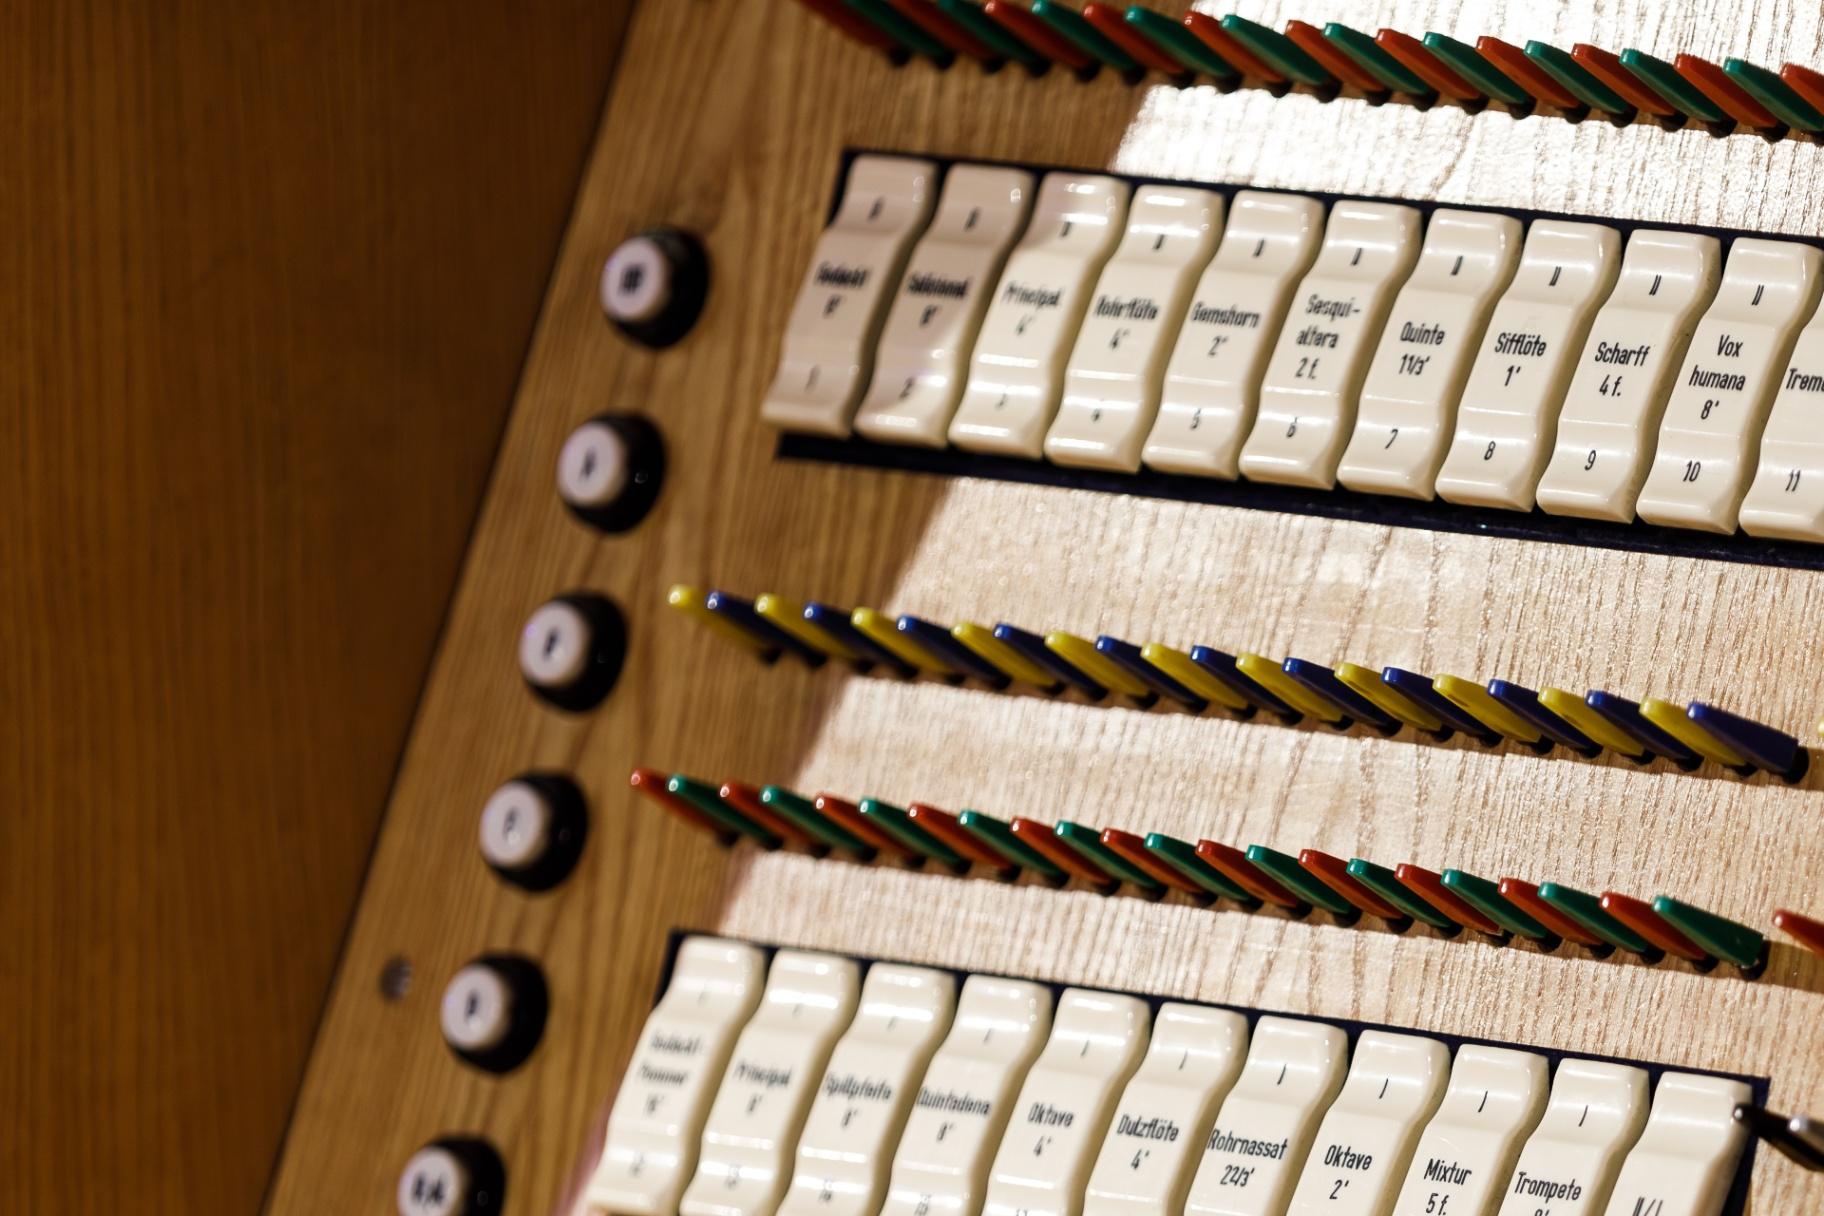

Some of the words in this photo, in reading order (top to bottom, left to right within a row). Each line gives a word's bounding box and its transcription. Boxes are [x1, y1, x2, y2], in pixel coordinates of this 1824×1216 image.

[1003, 280, 1063, 311] Principal
[1648, 274, 1663, 296] II
[1750, 284, 1765, 306] II
[1191, 301, 1261, 328] Gemshorn
[1304, 293, 1361, 322] Sesqui-
[1296, 325, 1340, 349] altera
[1399, 321, 1446, 346] Quinte
[1494, 331, 1548, 357] Sifflöte
[1594, 341, 1652, 367] Scharff
[1716, 334, 1744, 358] Vox
[1295, 357, 1308, 379] 2
[1688, 364, 1747, 392] humana
[1599, 374, 1610, 396] 4
[1611, 376, 1623, 397] f.
[1700, 399, 1720, 420] 8'
[1385, 428, 1399, 449] 7
[1484, 441, 1496, 461] 8
[1584, 449, 1597, 471] 9
[1682, 460, 1701, 483] 10
[1785, 468, 1801, 492] 11
[733, 1060, 794, 1089] Principal
[1027, 1102, 1074, 1129] Oktave
[1117, 1114, 1179, 1142] Dulzflöte
[1206, 1128, 1288, 1160] Rohrnassat
[1323, 1144, 1373, 1171] Oktave
[1423, 1158, 1472, 1186] Mixtur
[1329, 1179, 1350, 1200] 2'
[1514, 1171, 1582, 1204] Trompete
[1425, 1192, 1439, 1214] 5
[1438, 1194, 1450, 1216] f.
